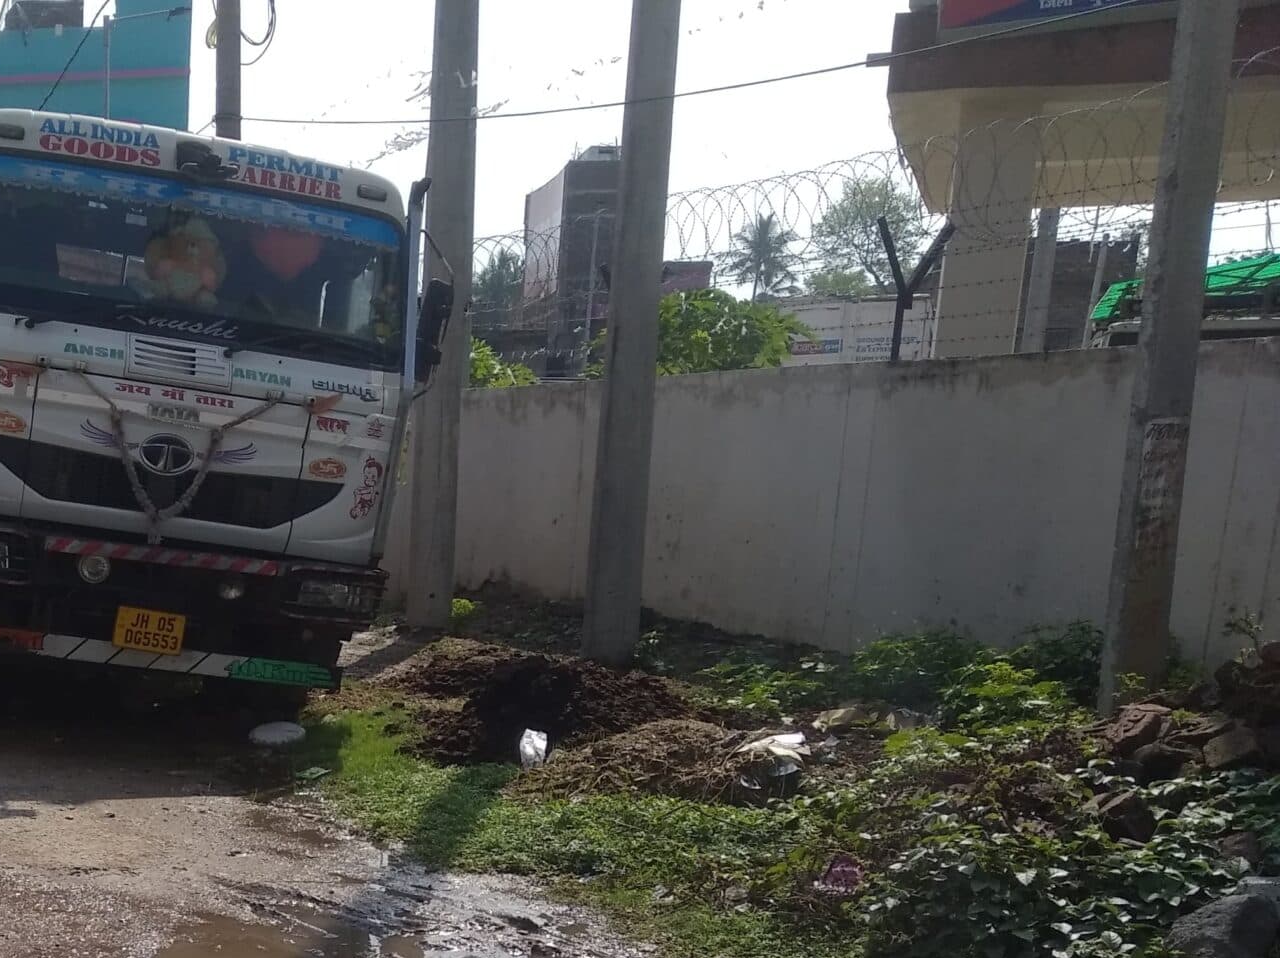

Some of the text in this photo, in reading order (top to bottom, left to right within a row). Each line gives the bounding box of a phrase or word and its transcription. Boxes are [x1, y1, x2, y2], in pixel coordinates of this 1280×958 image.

[40, 118, 160, 148] ALL INDIA
[40, 134, 160, 166] GOODS
[228, 146, 343, 181] PERMIT
[229, 164, 342, 199] ARRIER
[63, 342, 124, 360] ANSH
[232, 367, 291, 388] ARYAN
[115, 383, 151, 396] जय
[195, 394, 234, 408] तारा
[147, 402, 200, 422] TATA
[130, 613, 176, 633] JH 05
[124, 628, 179, 650] DG5553
